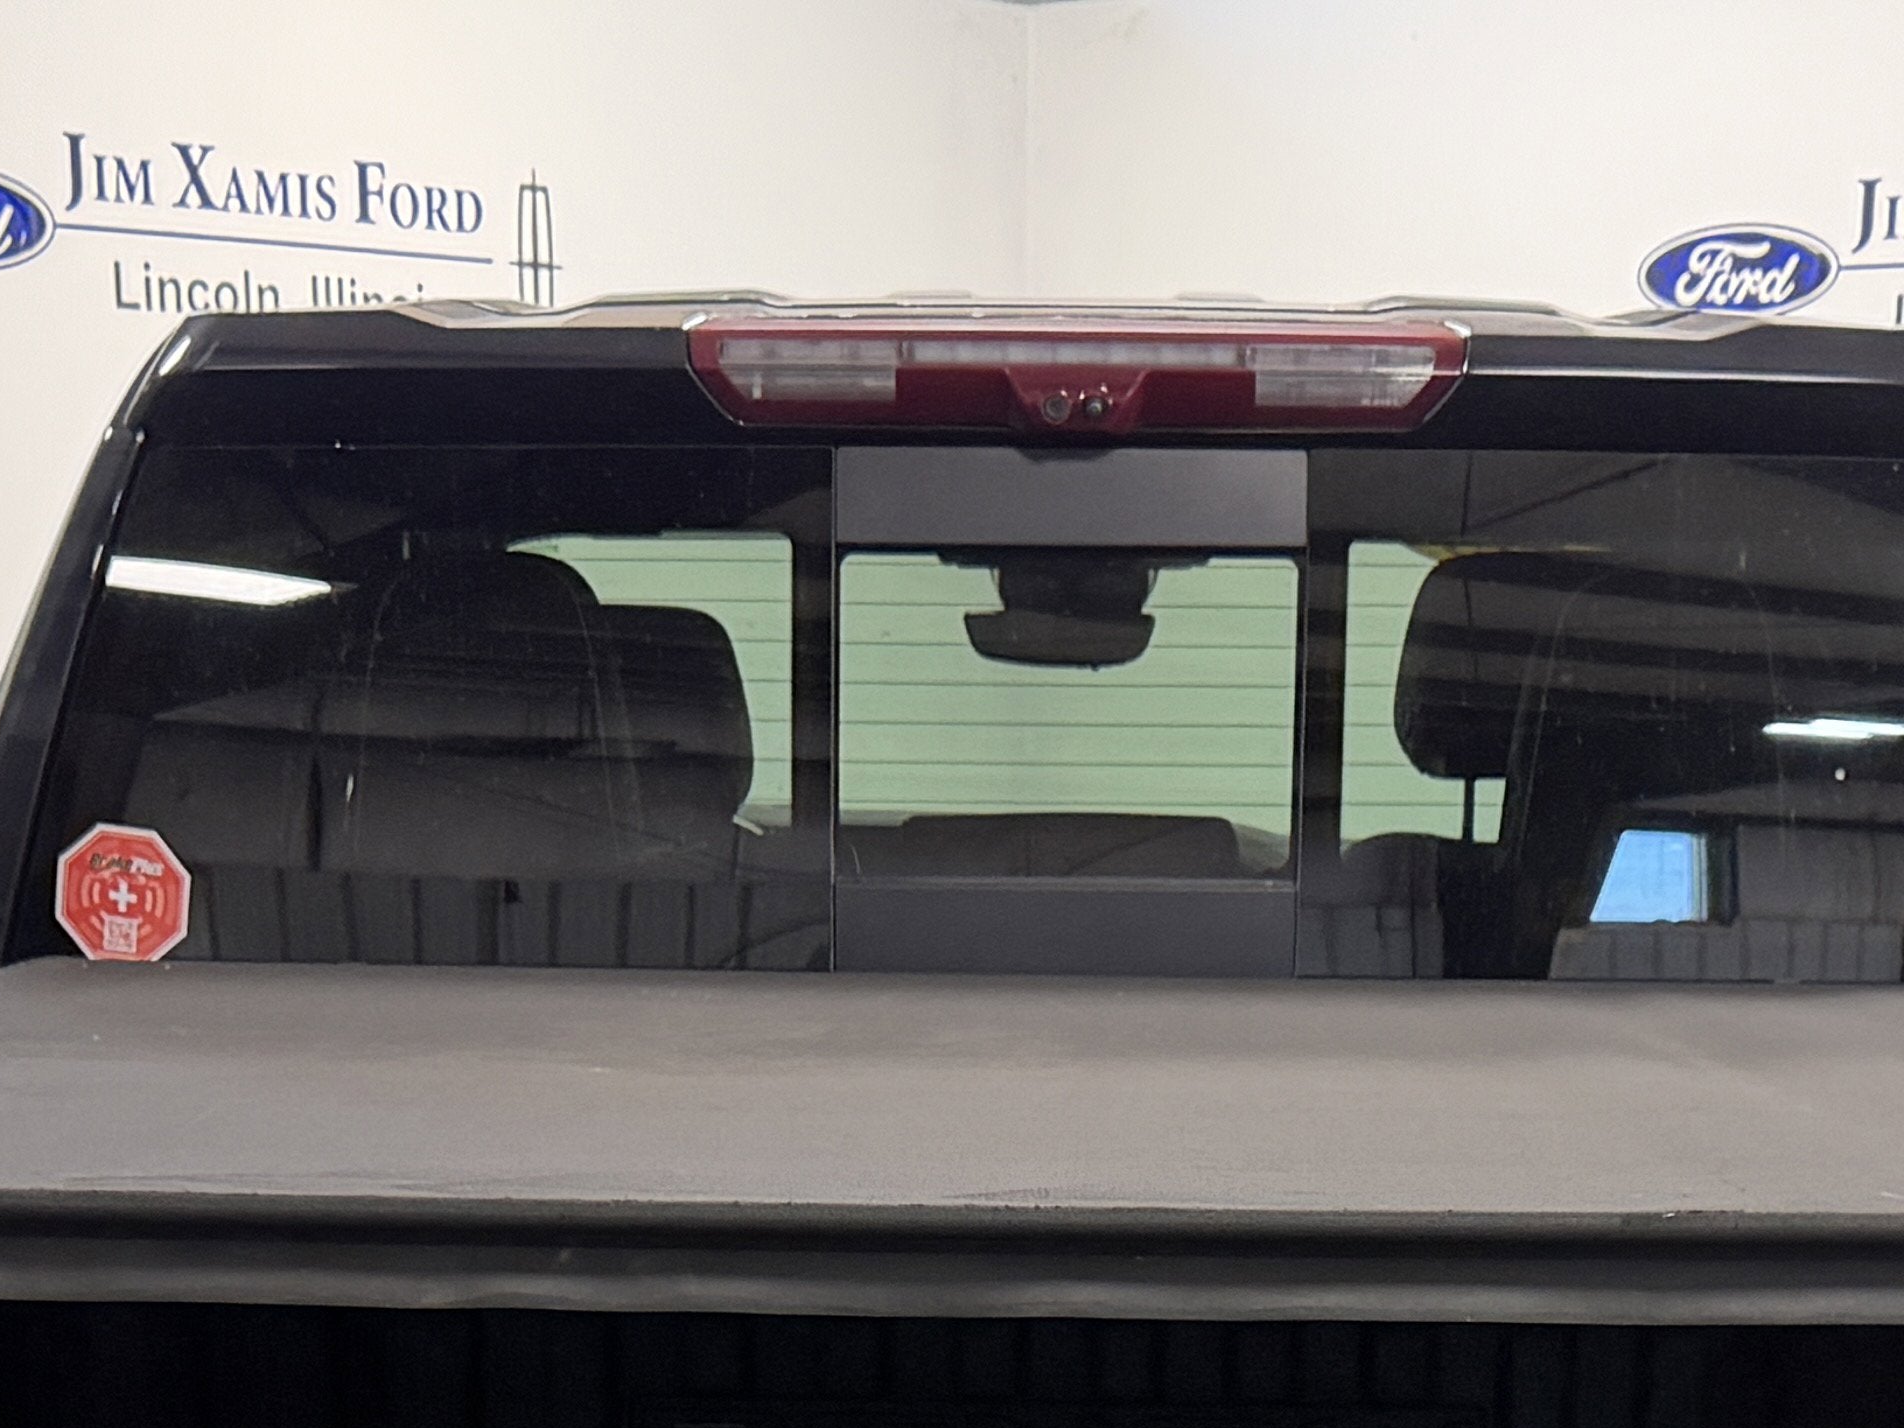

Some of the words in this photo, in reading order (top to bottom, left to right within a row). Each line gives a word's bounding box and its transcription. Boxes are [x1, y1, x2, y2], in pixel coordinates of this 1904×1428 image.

[61, 131, 155, 212] JIM
[170, 142, 338, 222] XAMIS
[353, 159, 485, 234] FORD
[1673, 239, 1801, 307] Ford
